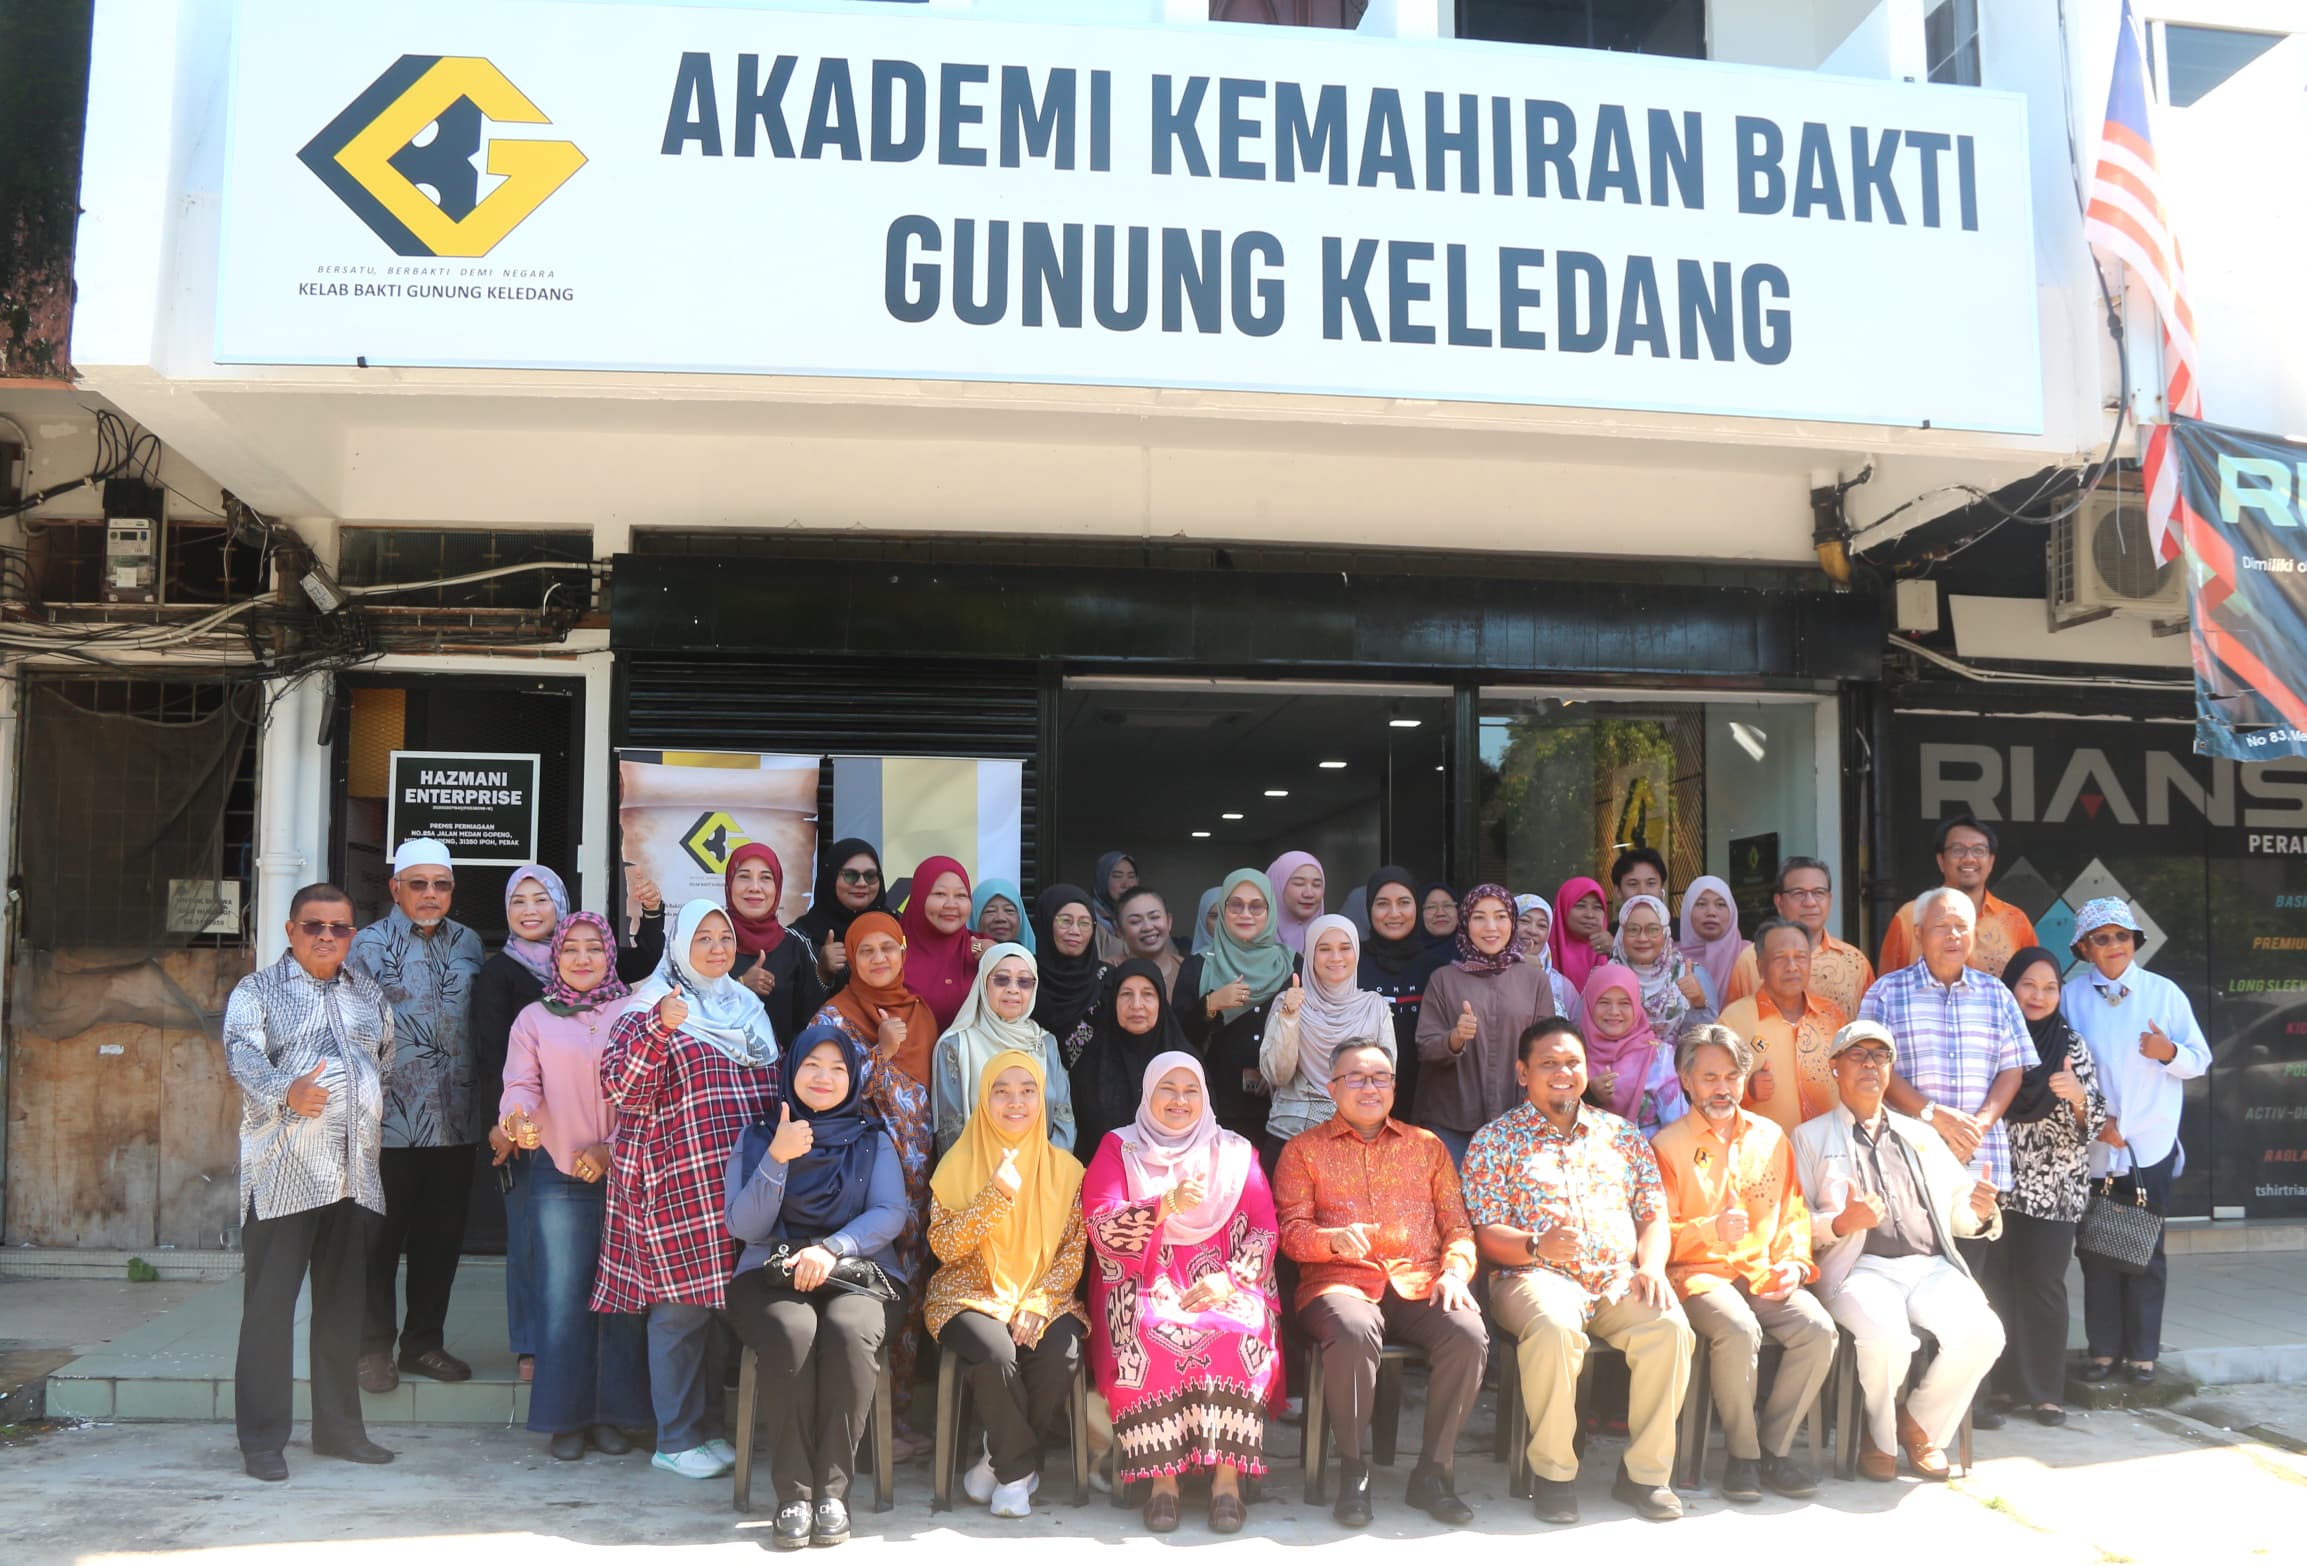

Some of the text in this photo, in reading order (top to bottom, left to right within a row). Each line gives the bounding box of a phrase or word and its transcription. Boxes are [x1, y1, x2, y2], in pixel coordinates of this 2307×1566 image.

[661, 51, 1979, 232] AKADEMI KEMAHIRAN BAKTI
[317, 265, 555, 278] BERSATU, BERBAKTI DEMI NEGARA
[299, 282, 574, 301] KELAB BAKTI GUNUNG KELEDANG
[885, 214, 1792, 365] GUNUNG KELEDANG
[2242, 556, 2307, 573] Dimiliki o
[2246, 734, 2266, 748] No
[420, 770, 508, 786] HAZMANI
[1920, 742, 2307, 829] RIANS
[405, 788, 522, 805] ENTERPRISE
[2228, 978, 2265, 992] LONG
